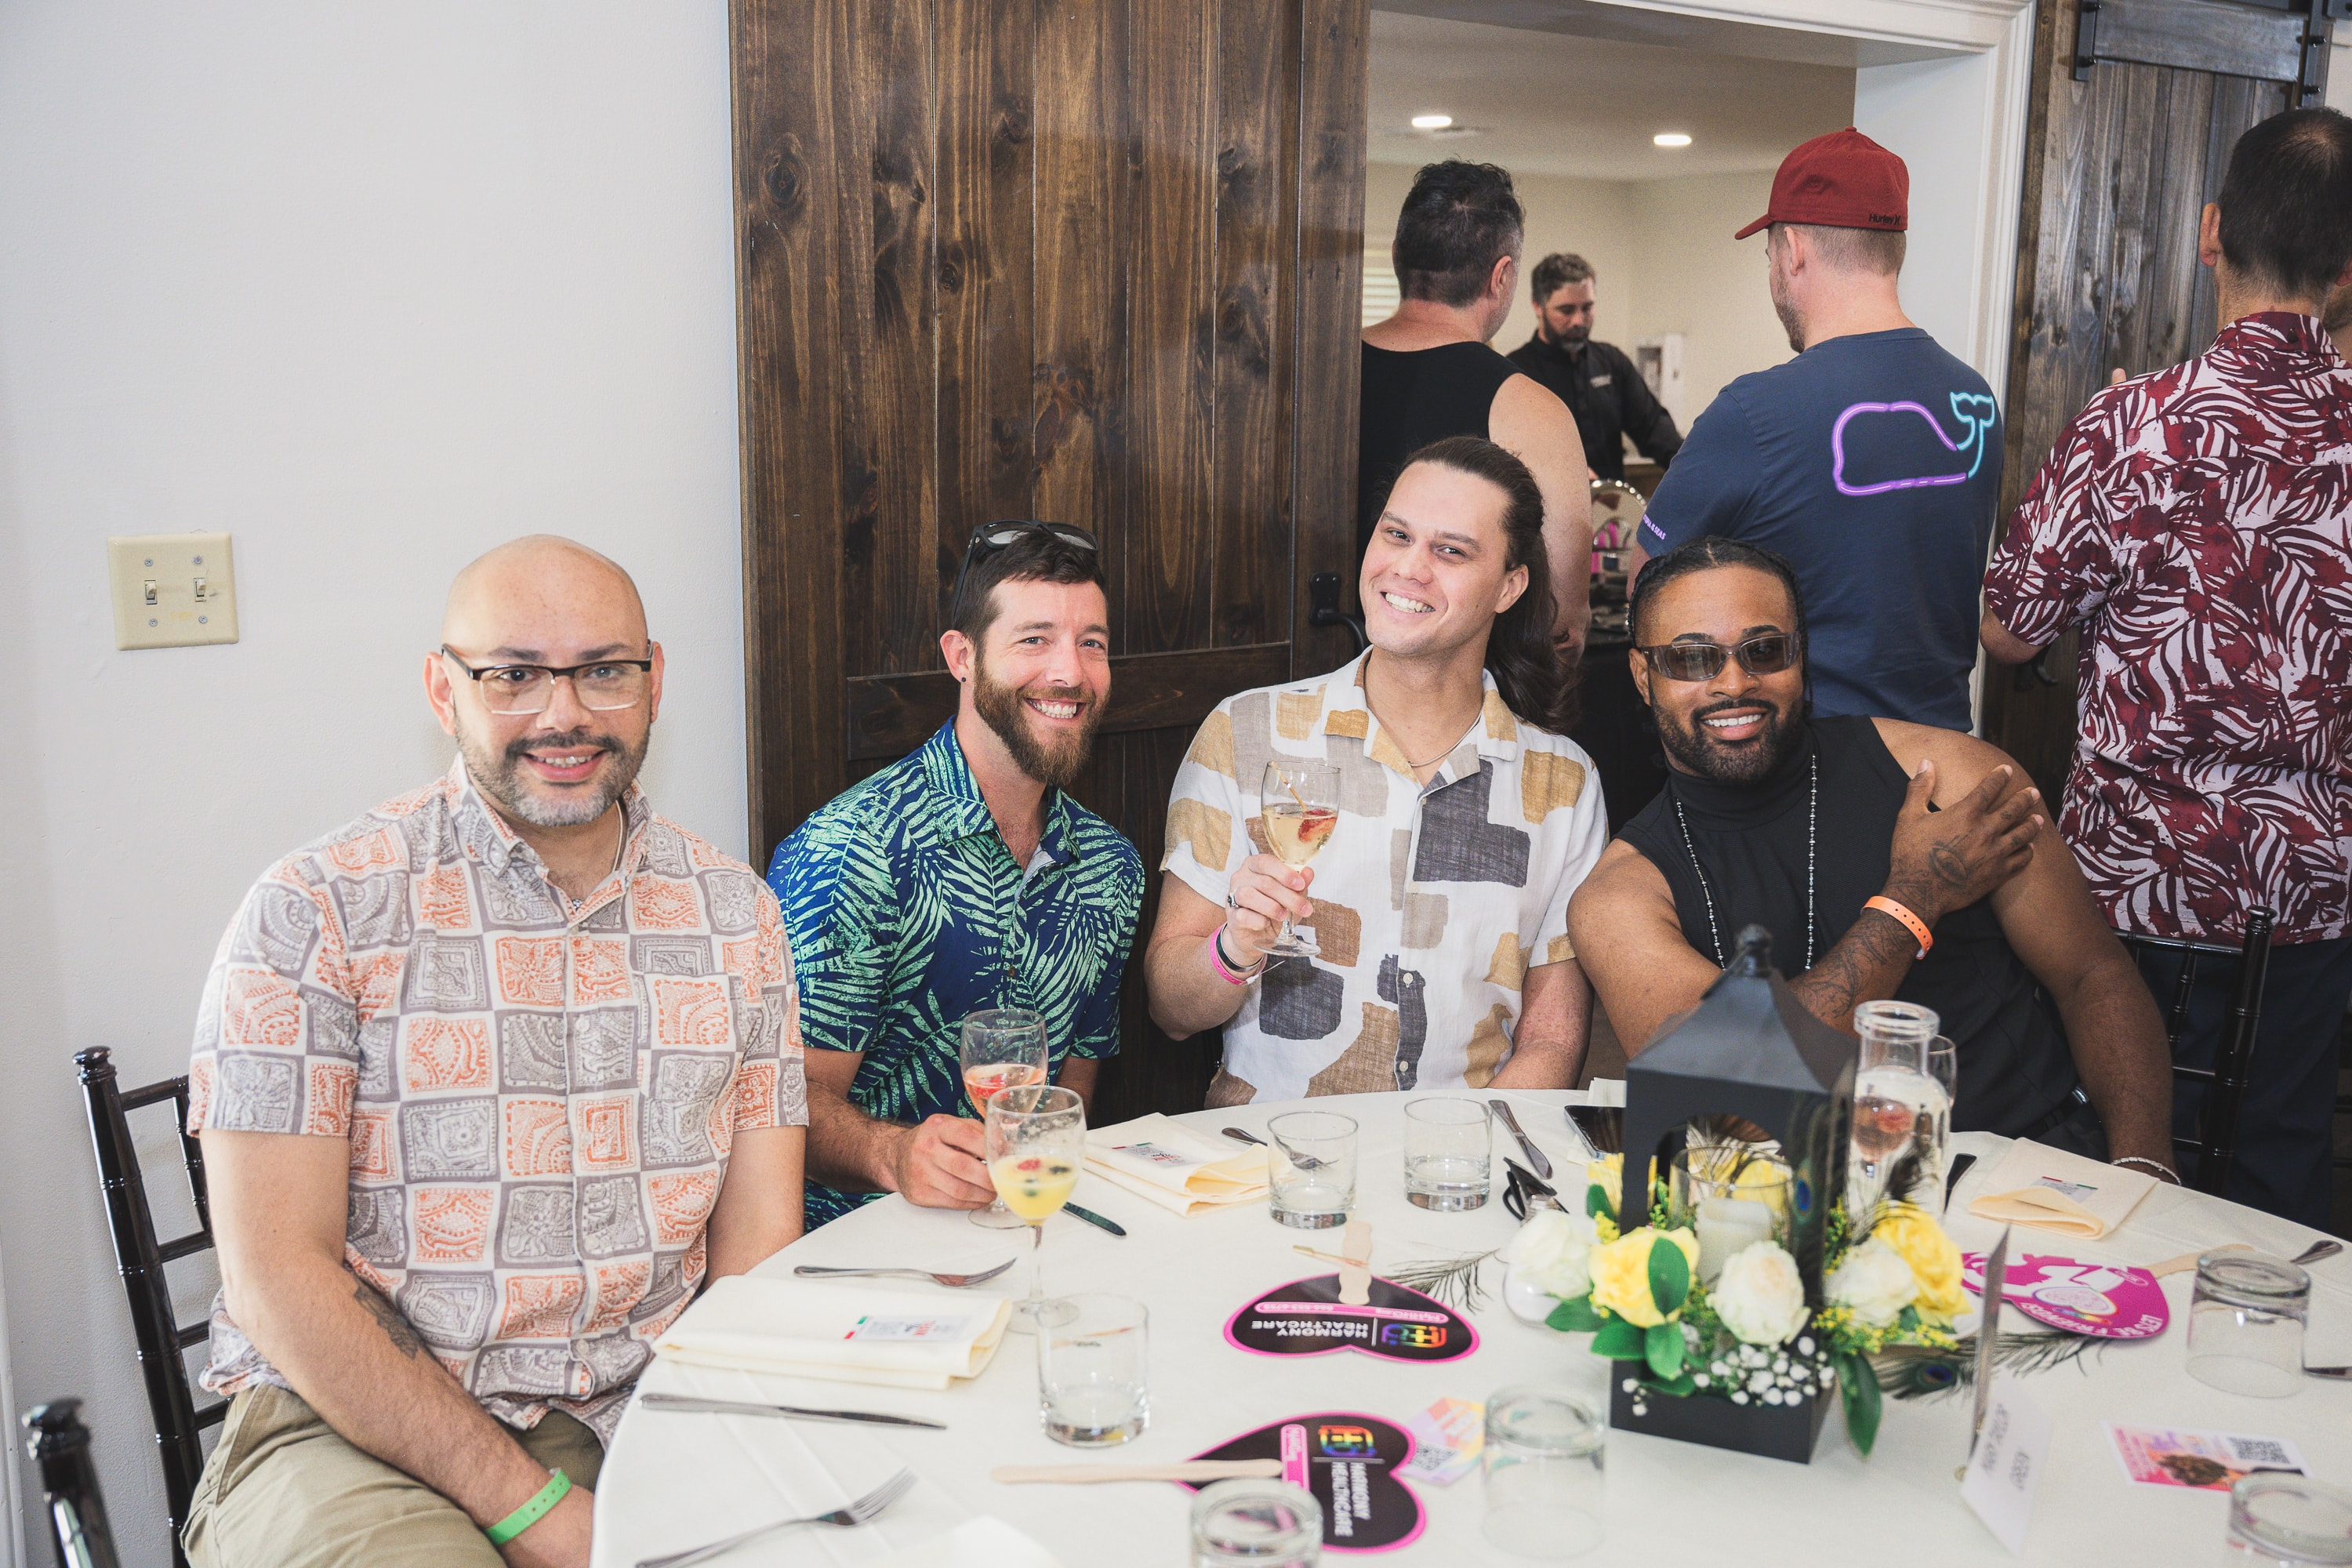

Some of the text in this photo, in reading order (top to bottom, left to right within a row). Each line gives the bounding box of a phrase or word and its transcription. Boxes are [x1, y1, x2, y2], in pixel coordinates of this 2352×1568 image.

[1868, 213, 1894, 225] Hurley
[1251, 1320, 1368, 1330] HEALTHCARE
[2020, 1301, 2108, 1336] FRIENDS
[1276, 1327, 1368, 1338] HARMONY
[1331, 1462, 1354, 1537] HEALTHCARE
[1349, 1462, 1371, 1520] HARMONY
